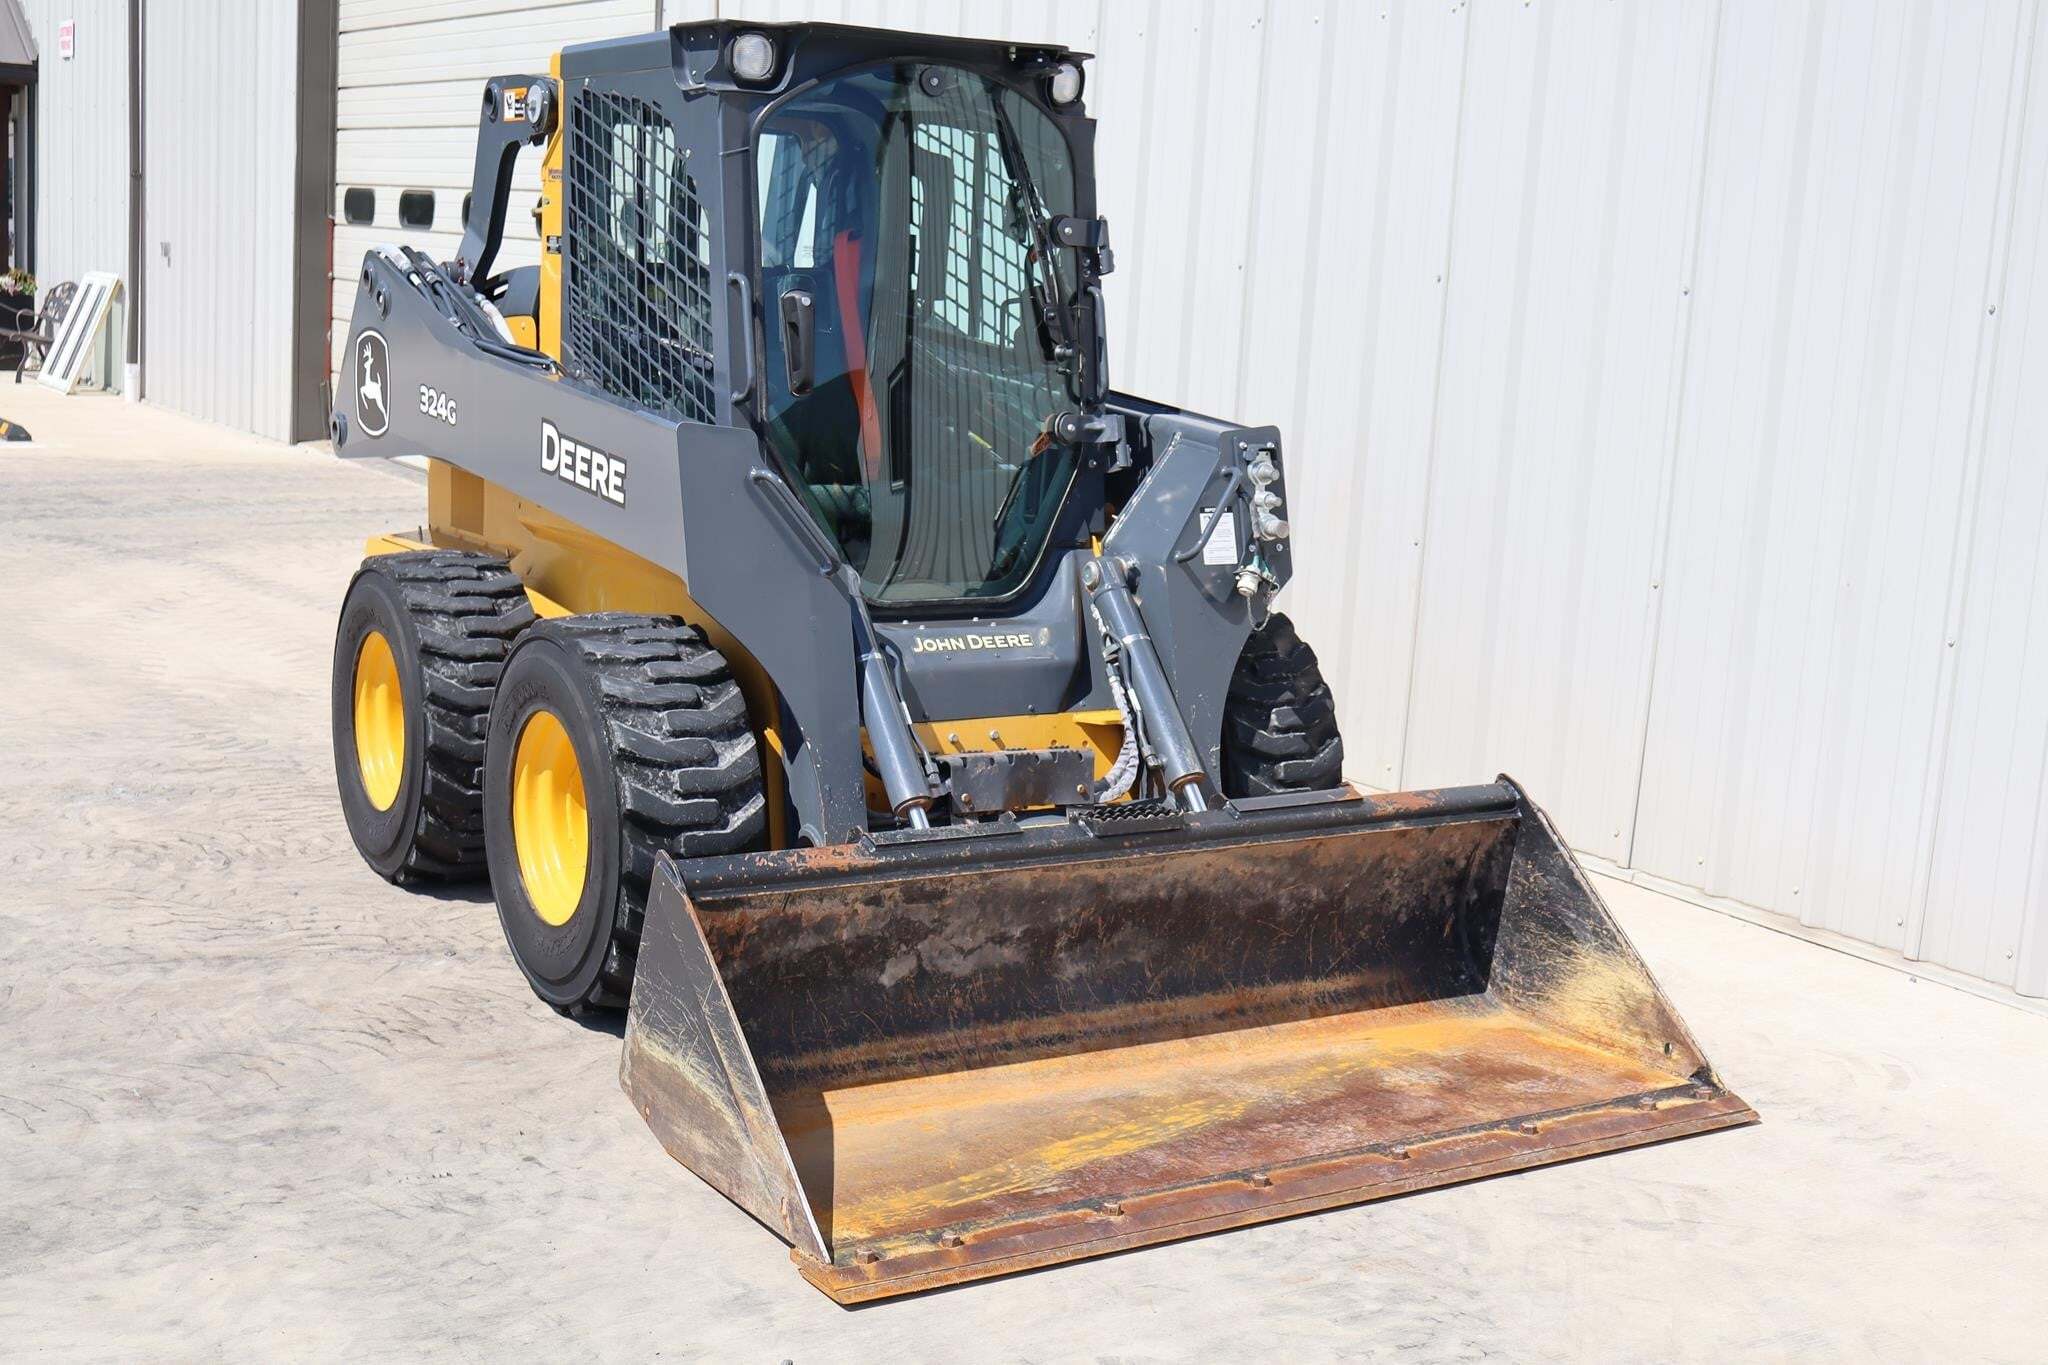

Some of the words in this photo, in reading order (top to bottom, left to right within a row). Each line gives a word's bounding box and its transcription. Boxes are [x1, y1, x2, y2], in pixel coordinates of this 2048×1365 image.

[419, 384, 457, 426] 324G
[540, 421, 626, 504] DEERE
[913, 637, 965, 653] JOHN
[967, 634, 1033, 650] DEERE
